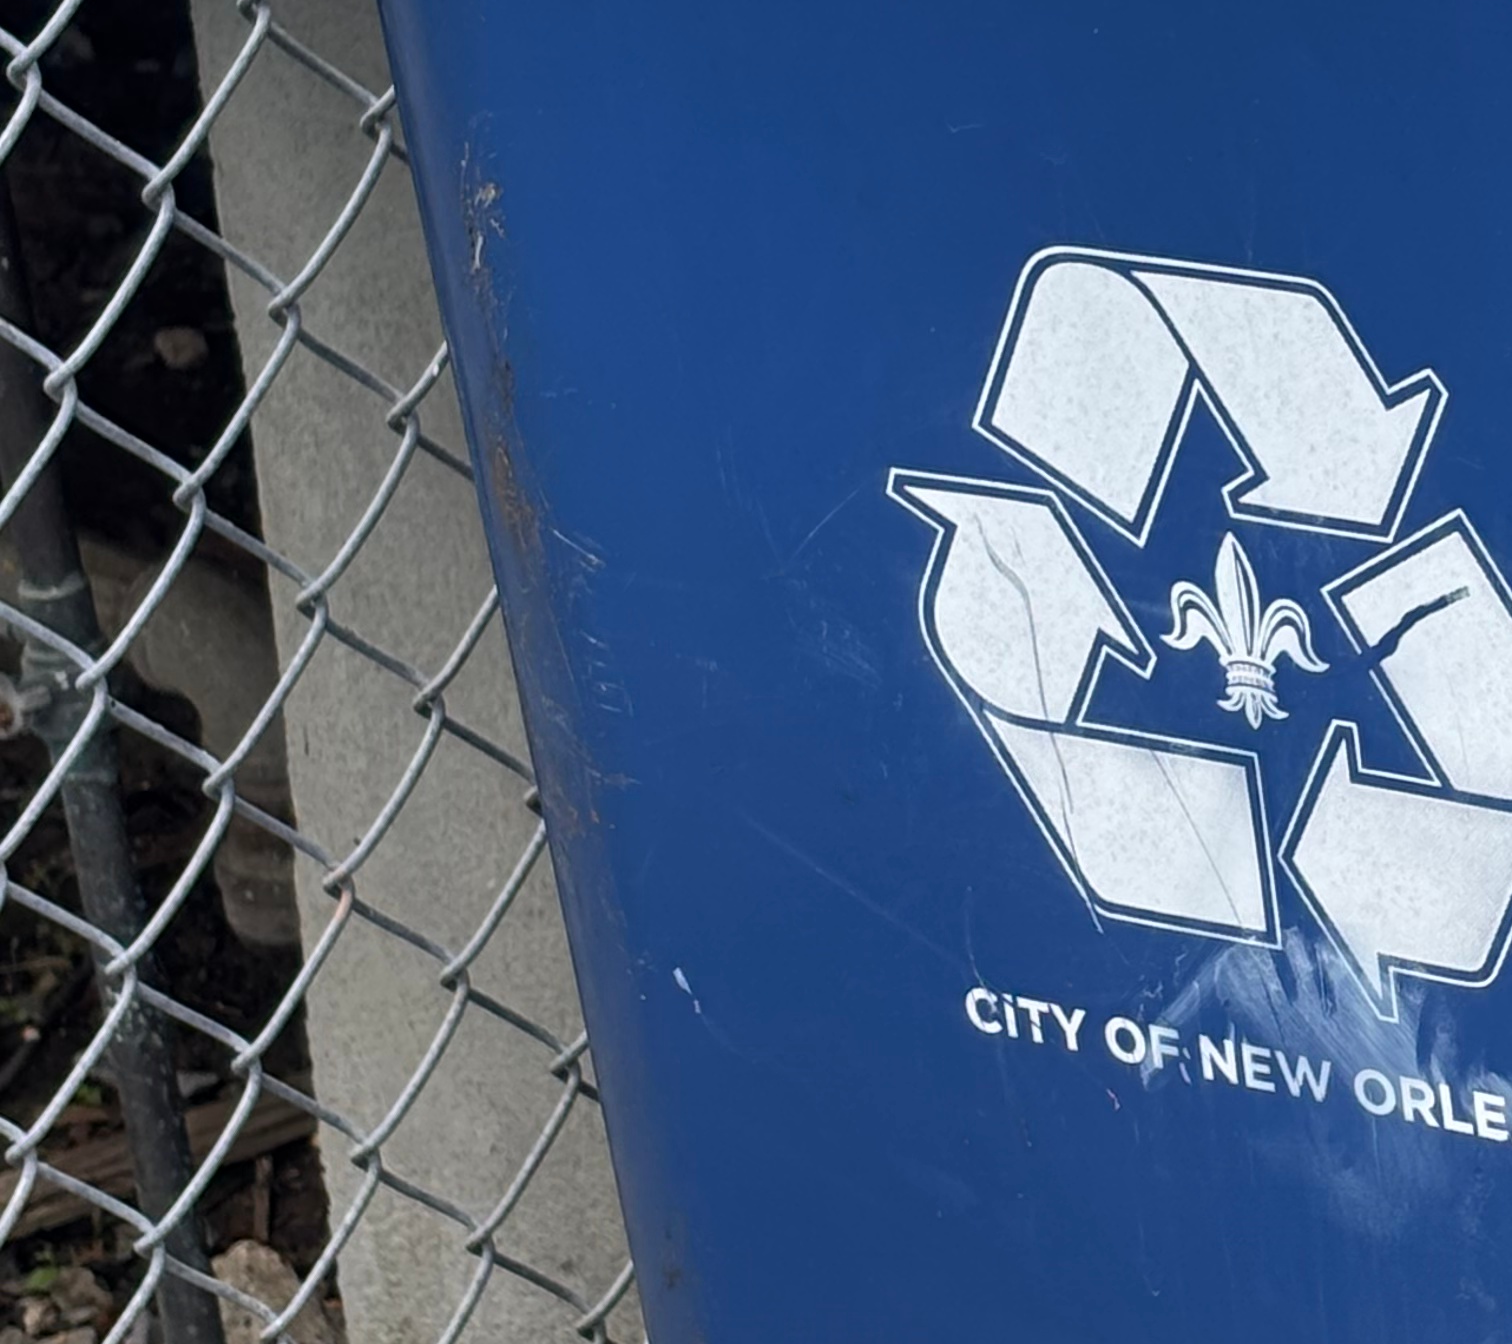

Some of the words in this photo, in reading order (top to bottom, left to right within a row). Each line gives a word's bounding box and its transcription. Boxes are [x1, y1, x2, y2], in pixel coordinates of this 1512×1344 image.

[965, 987, 1086, 1052] CITY
[1104, 1016, 1179, 1069] OF
[1198, 1031, 1332, 1102] NEW
